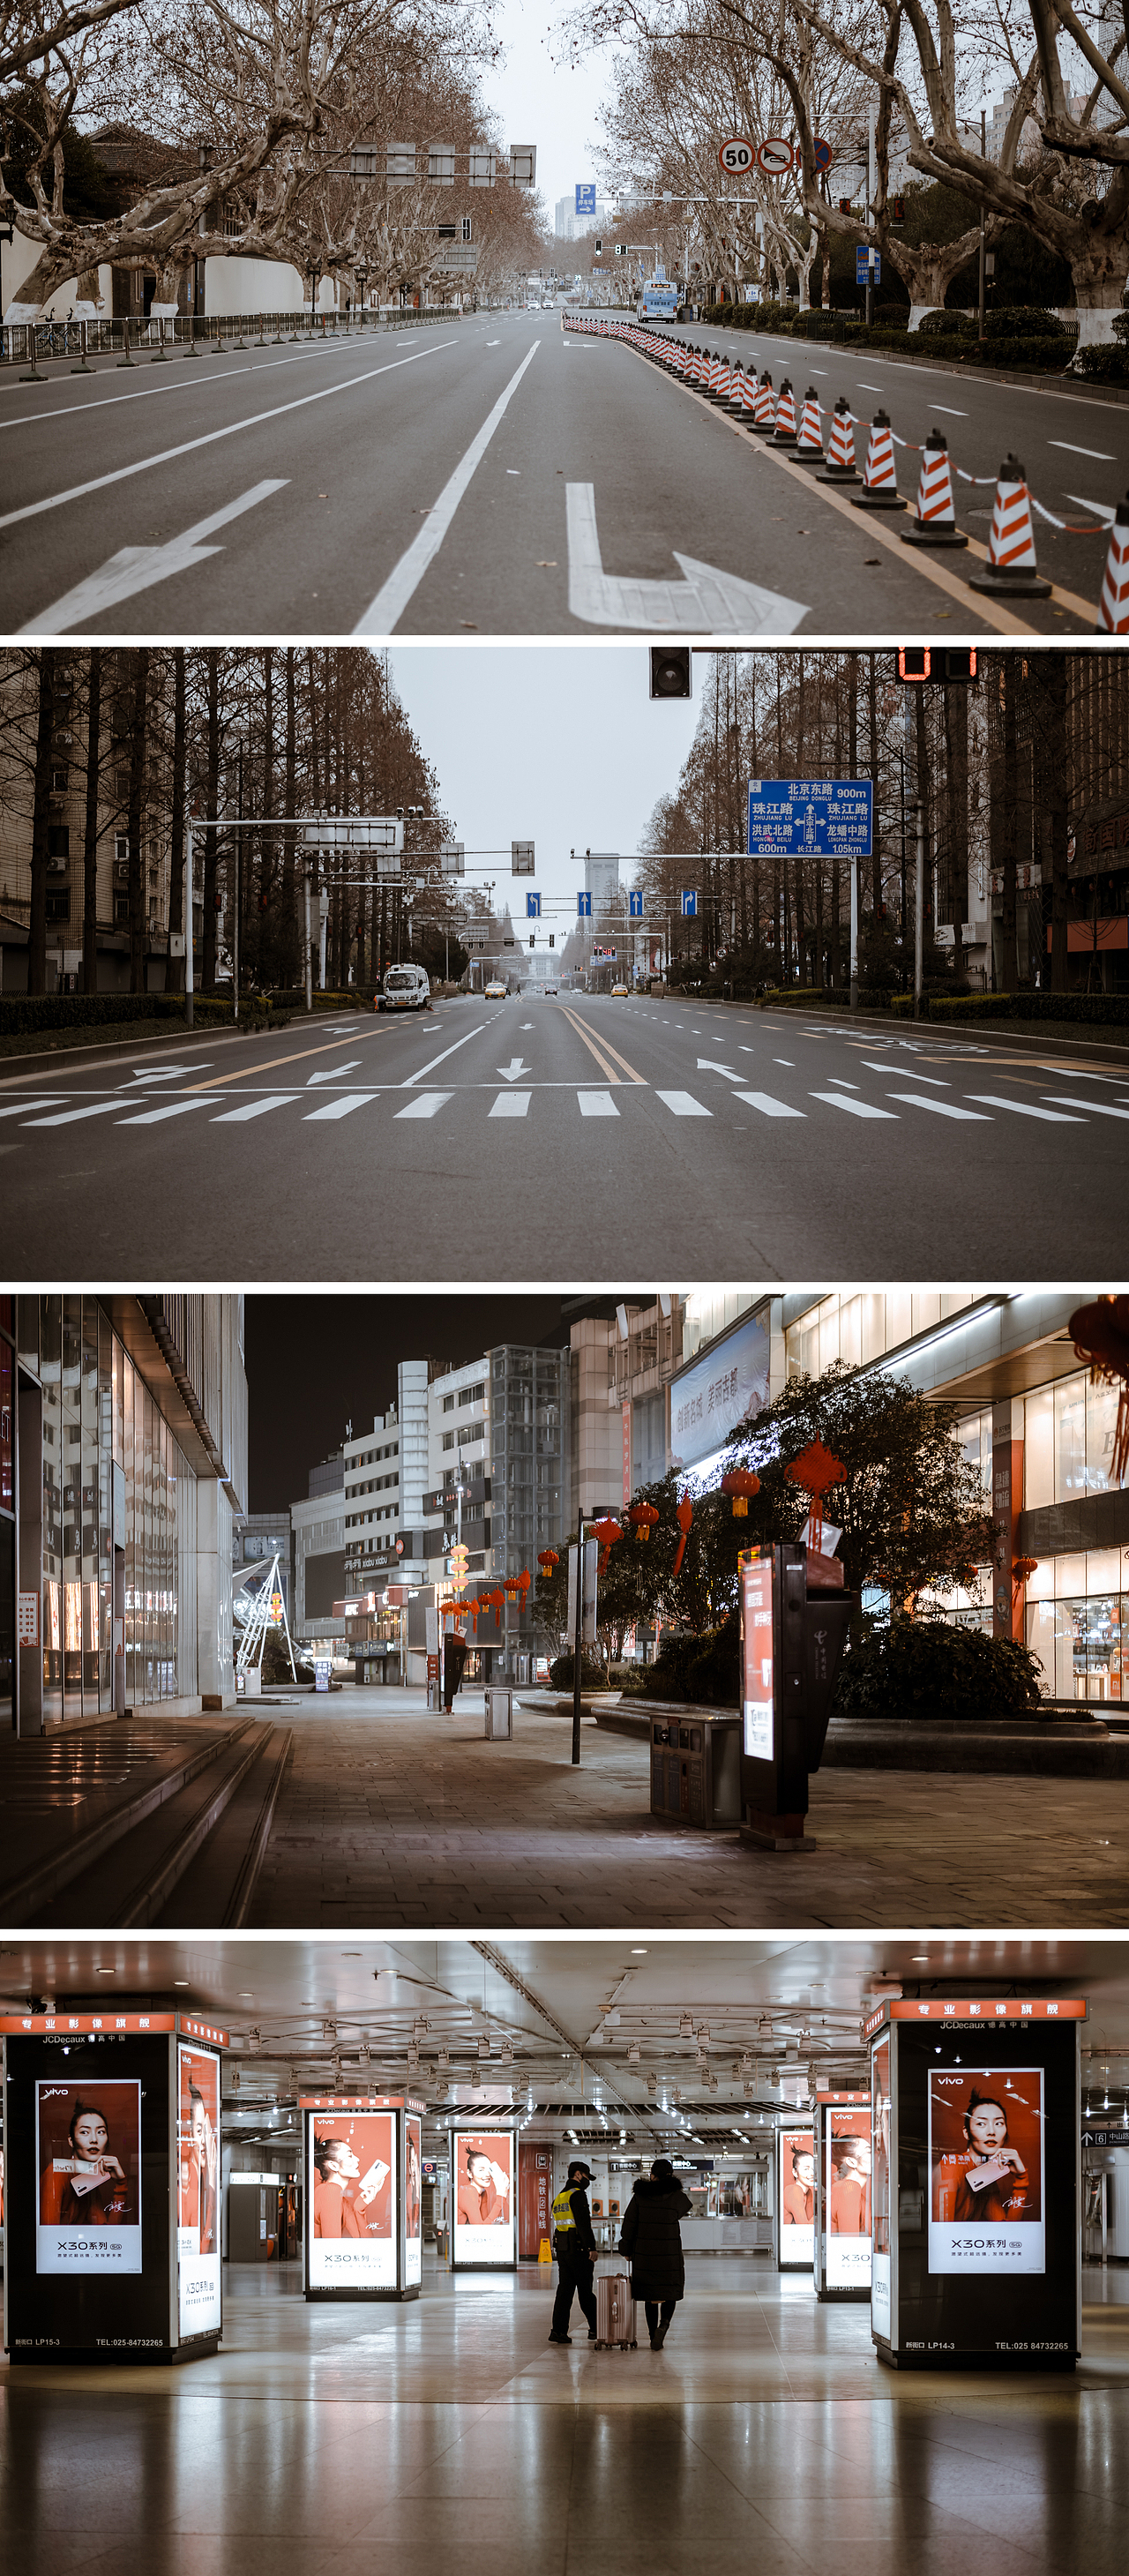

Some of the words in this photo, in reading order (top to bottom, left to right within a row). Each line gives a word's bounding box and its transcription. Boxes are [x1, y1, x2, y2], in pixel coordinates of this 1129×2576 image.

[726, 149, 748, 166] 50
[579, 185, 591, 198] P
[788, 783, 833, 795] 北京东路
[837, 789, 866, 798] 900m
[752, 803, 793, 814] 珠江路
[827, 803, 869, 814] 珠江路
[752, 824, 793, 836] 洪武北路
[805, 815, 814, 841] 太平北路
[826, 824, 869, 836] 龙蟠中路
[758, 843, 787, 853] 600m
[833, 844, 862, 854] 1.05km
[677, 1392, 703, 1433] 创新名城
[707, 1367, 738, 1413] 美丽古都
[918, 2003, 1059, 2015] 专业影像旗舰
[21, 2018, 150, 2029] 专业影像旗舰
[42, 2035, 86, 2044] JCDecaux
[938, 2077, 964, 2086] vivo
[57, 2242, 108, 2250] X30系列
[951, 2239, 1006, 2249] X30系列
